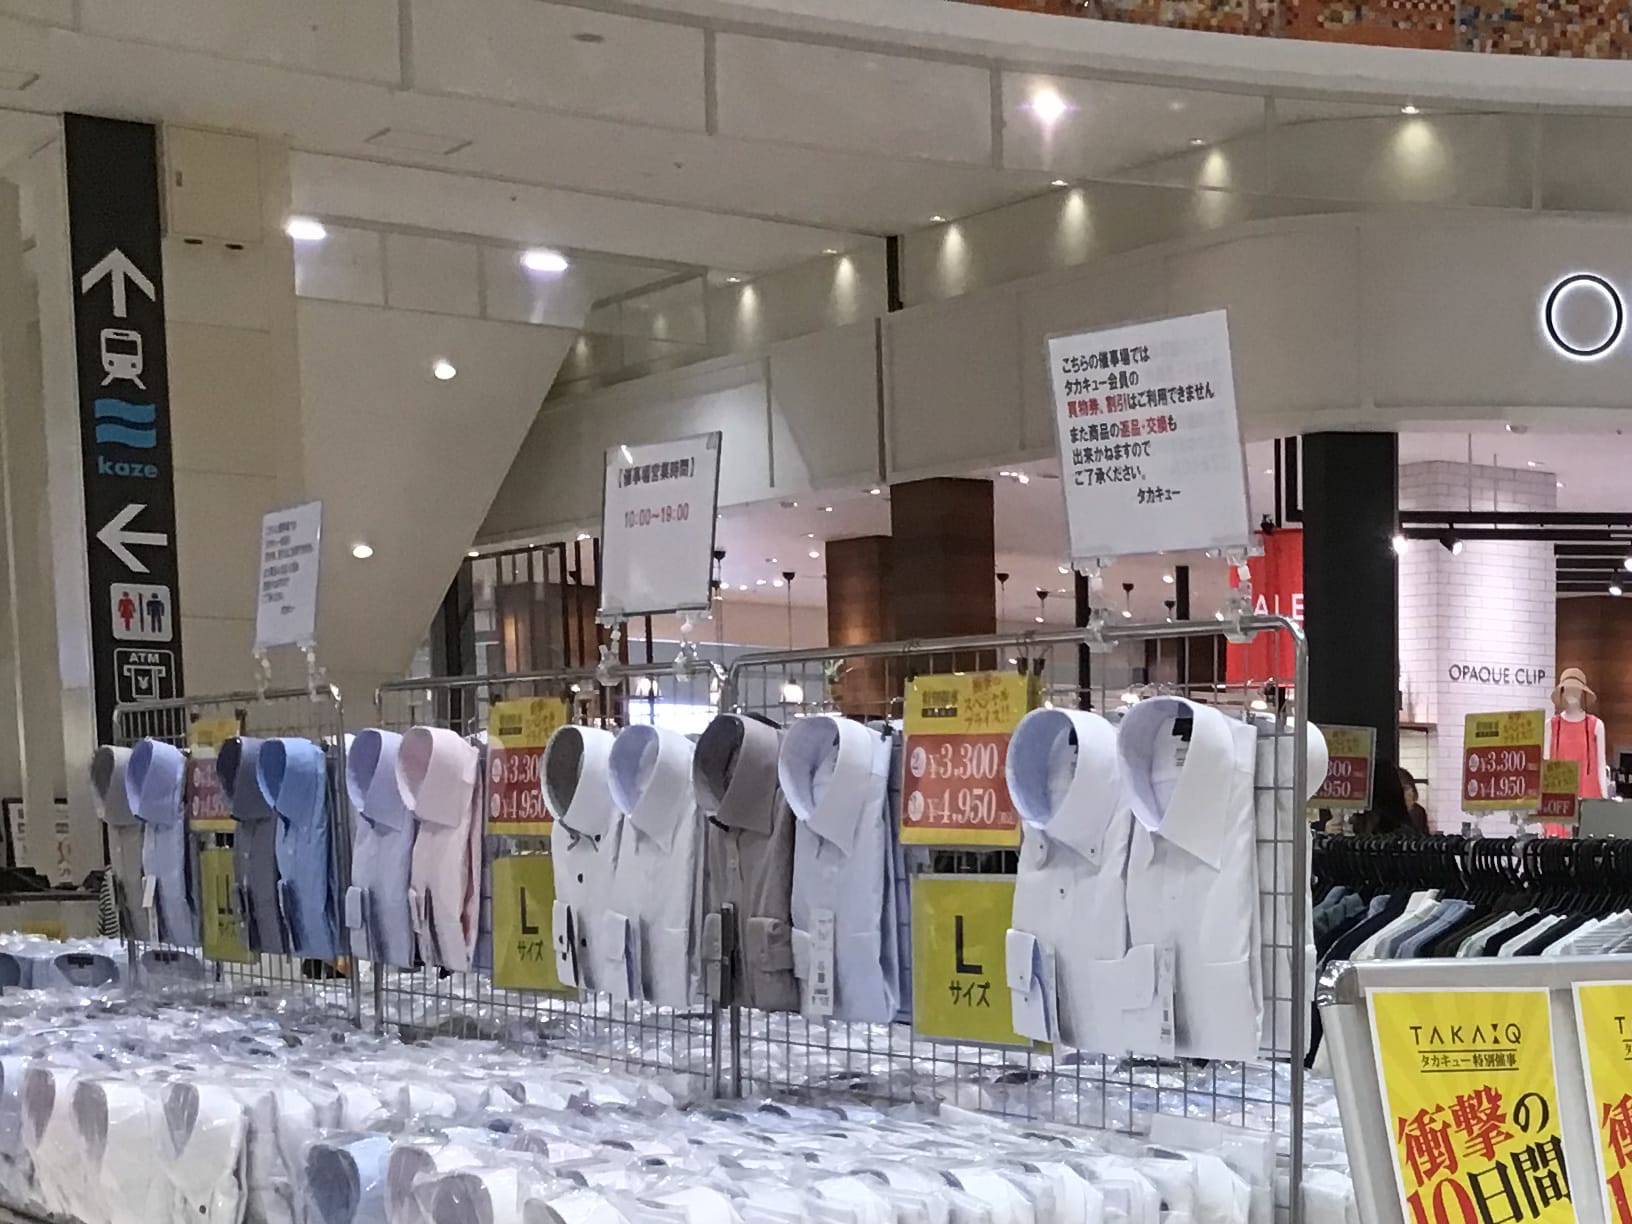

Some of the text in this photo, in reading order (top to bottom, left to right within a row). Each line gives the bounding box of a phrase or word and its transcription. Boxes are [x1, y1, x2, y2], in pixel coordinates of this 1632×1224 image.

[97, 456, 158, 479] kaze
[1137, 487, 1181, 505] タカキュー
[128, 652, 160, 665] ATM
[519, 887, 539, 936] L
[517, 938, 544, 962] サイズ
[954, 915, 983, 975] L
[949, 980, 990, 1008] サイズ
[1397, 1084, 1550, 1187] 衝撃の
